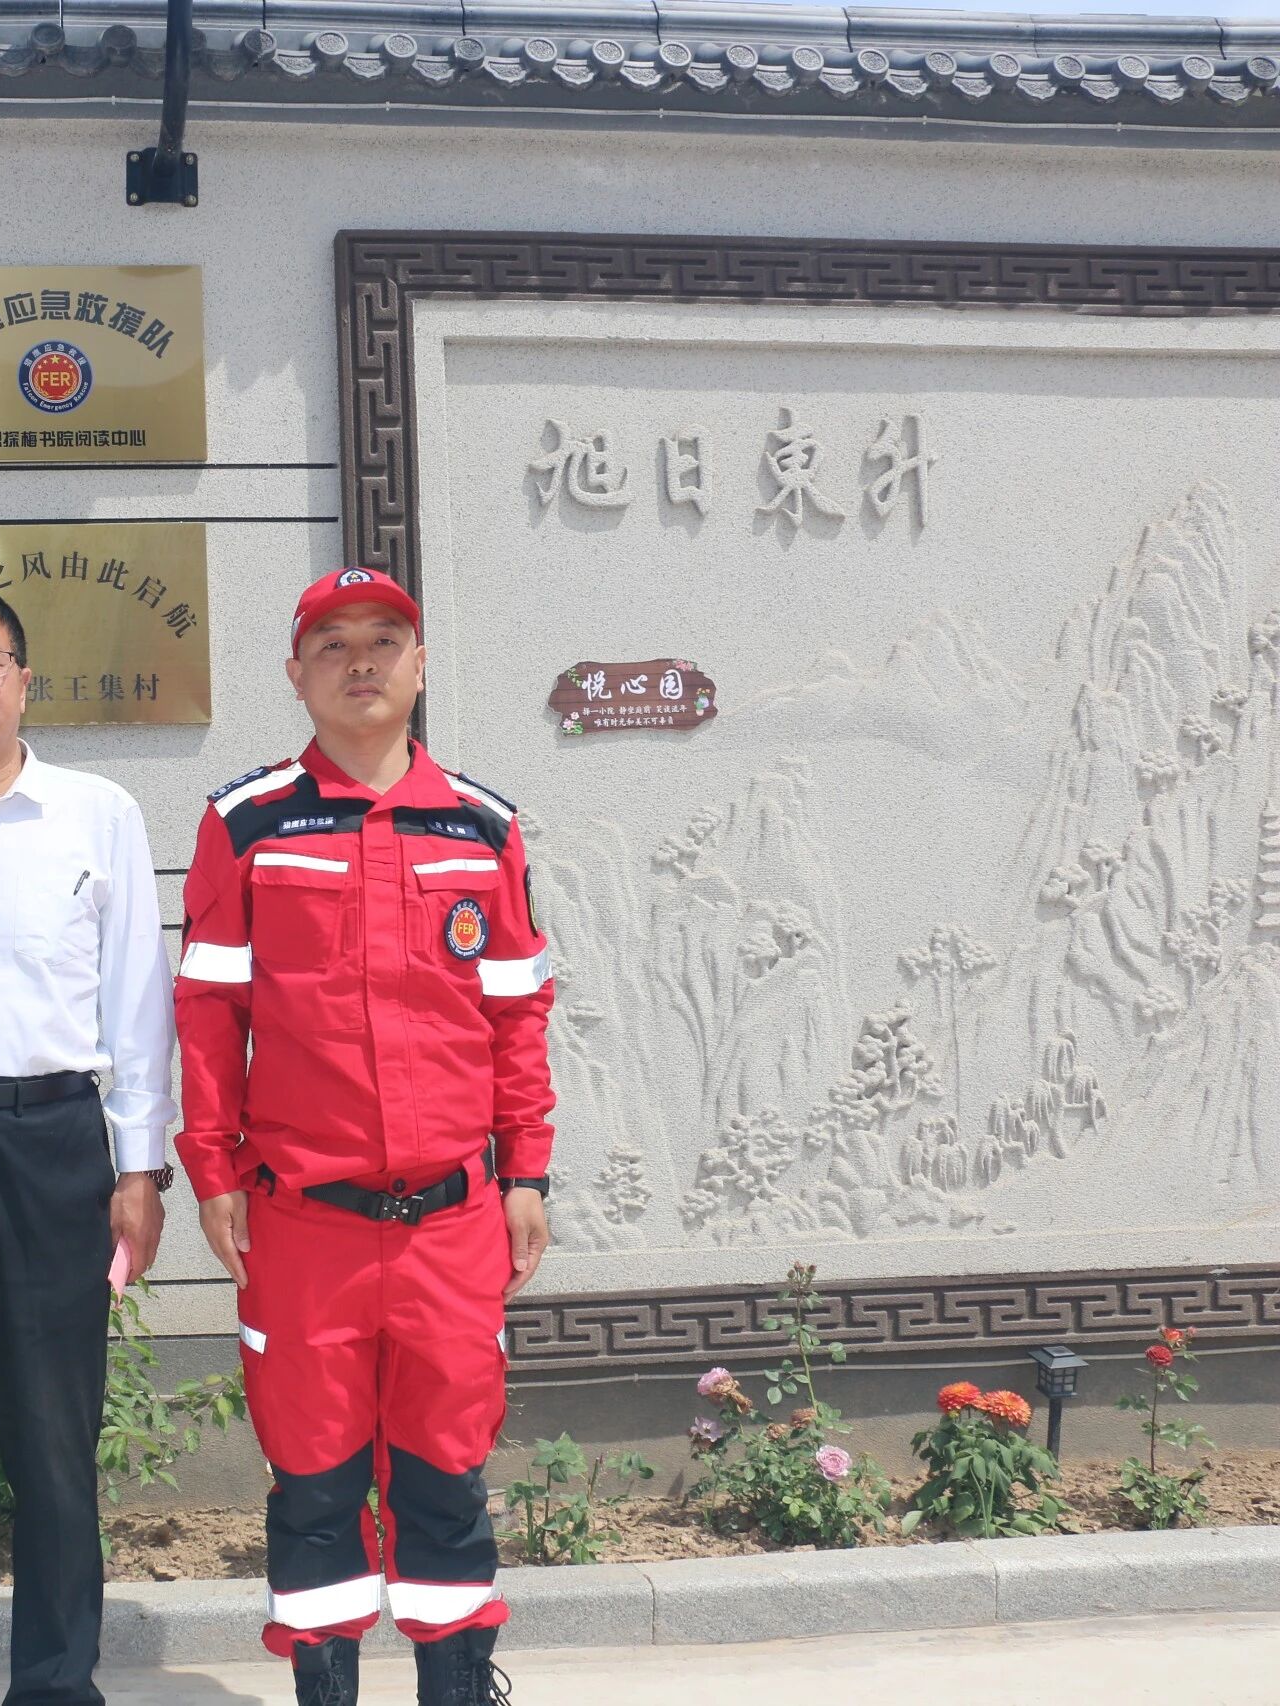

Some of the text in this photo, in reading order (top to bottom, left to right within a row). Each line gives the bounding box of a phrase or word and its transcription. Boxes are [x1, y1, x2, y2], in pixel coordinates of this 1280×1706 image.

[40, 371, 71, 387] FER
[27, 673, 160, 702] 张王集村
[457, 923, 475, 935] FER
